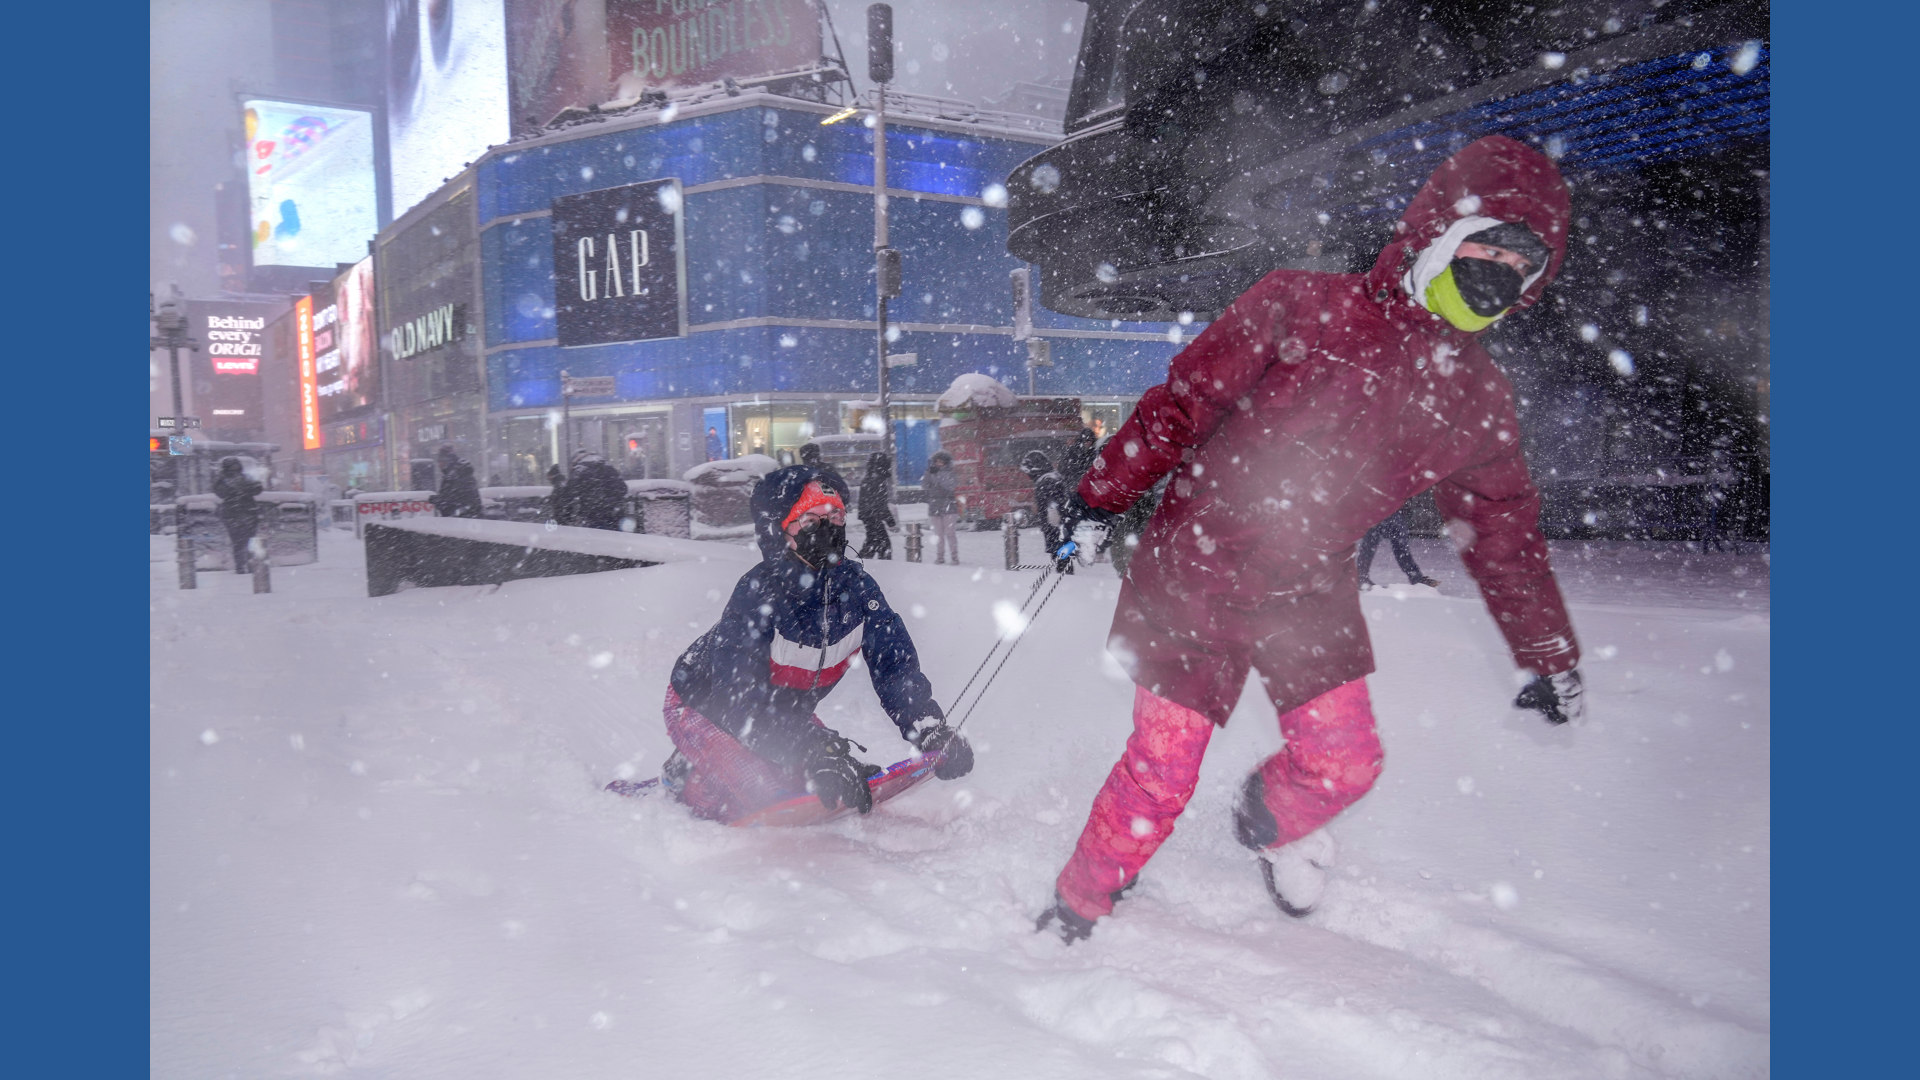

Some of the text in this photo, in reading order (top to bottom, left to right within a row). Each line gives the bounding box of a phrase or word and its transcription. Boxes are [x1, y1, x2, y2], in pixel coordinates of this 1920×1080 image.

[632, 0, 791, 79] BOUNDLESS
[578, 229, 649, 301] GAP
[208, 316, 264, 329] Behind
[208, 330, 252, 344] every
[392, 303, 453, 360] OLD NAVY
[358, 501, 434, 515] CHICAGO
